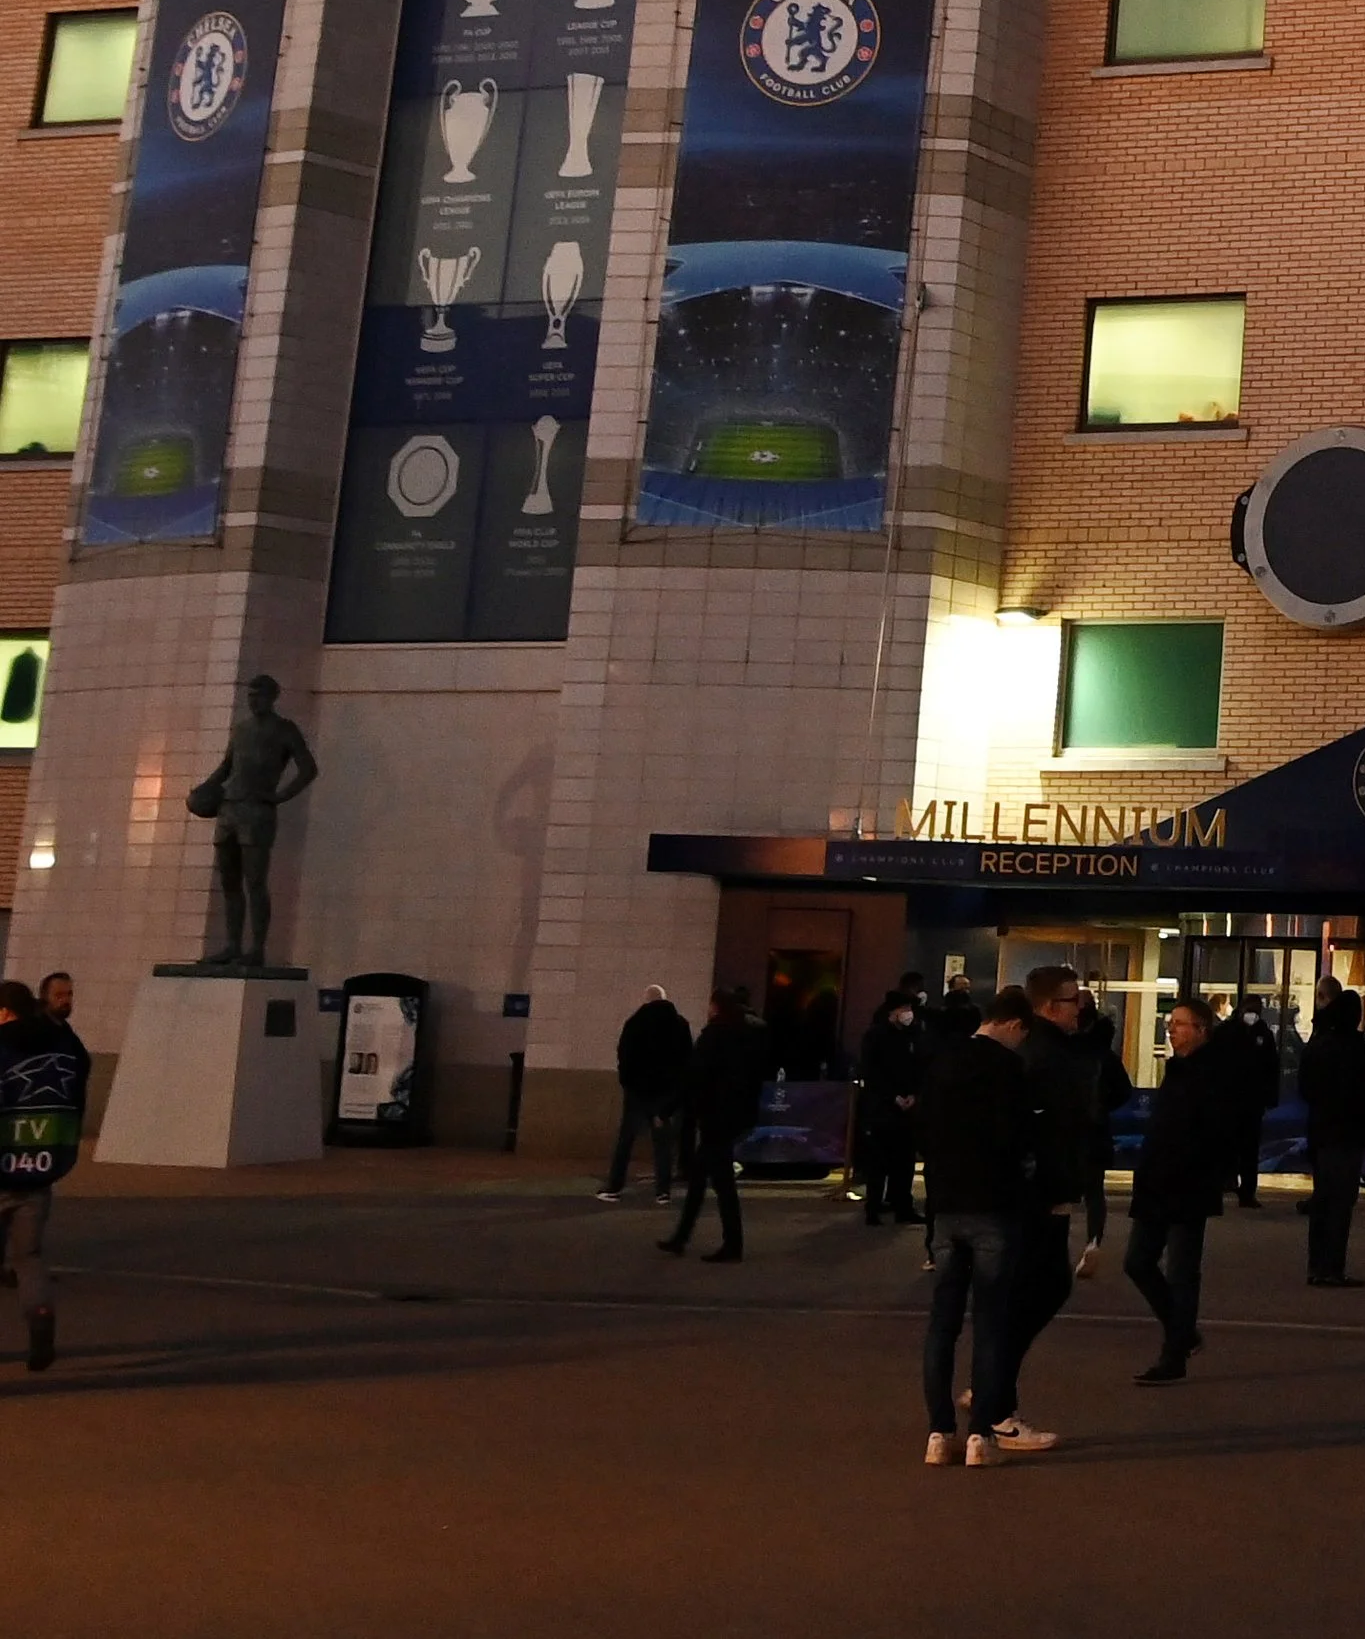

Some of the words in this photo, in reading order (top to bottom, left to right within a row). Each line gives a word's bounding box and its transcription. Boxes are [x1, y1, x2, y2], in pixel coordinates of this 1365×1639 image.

[187, 15, 237, 48] CHELSEA
[759, 72, 816, 99] FOOTBALL
[821, 73, 852, 97] CLUB
[894, 798, 1228, 849] MILLENNIUM
[980, 850, 1138, 877] RECEPTION
[10, 1118, 49, 1141] TV
